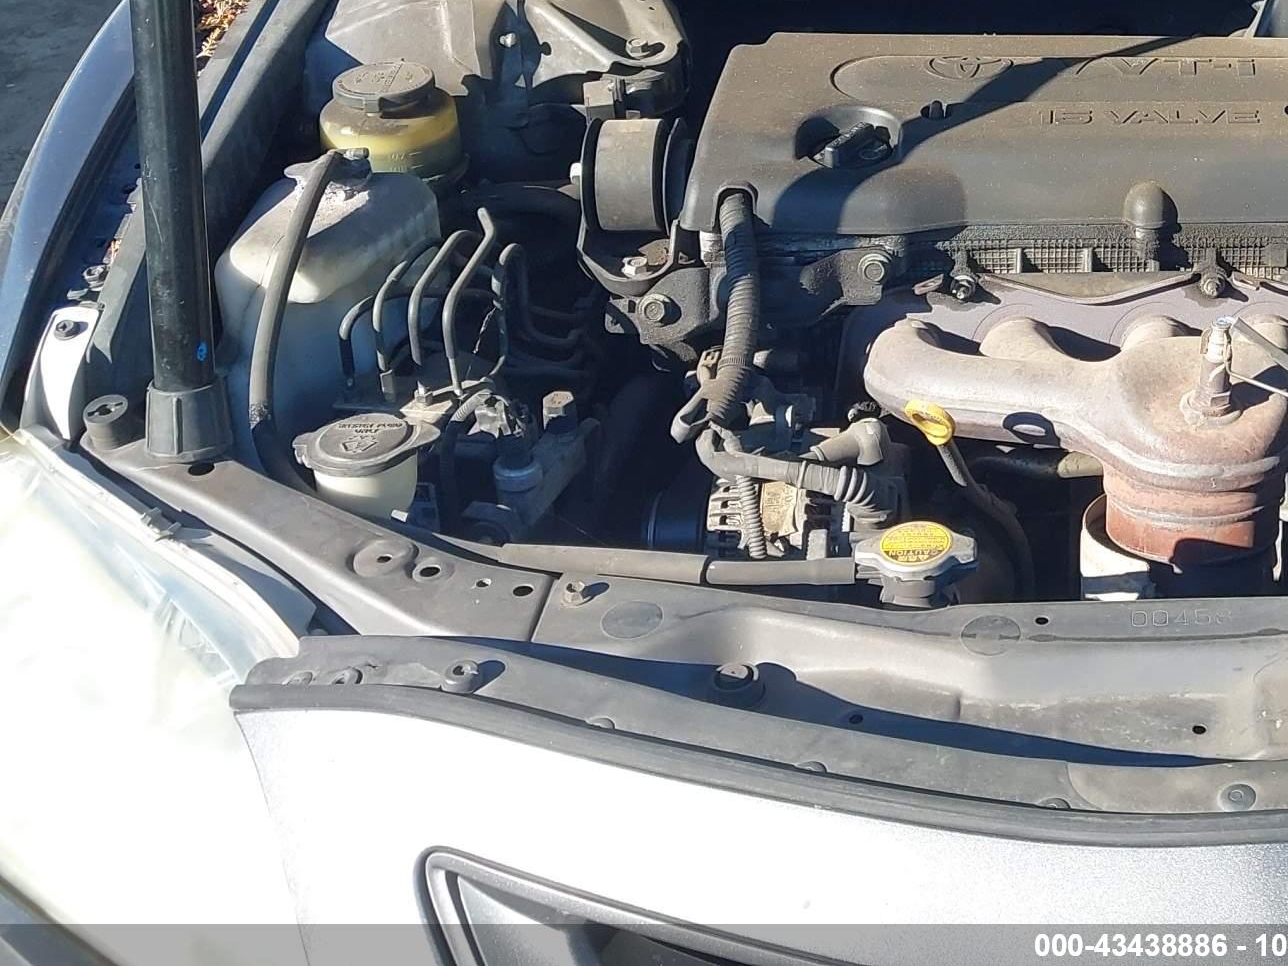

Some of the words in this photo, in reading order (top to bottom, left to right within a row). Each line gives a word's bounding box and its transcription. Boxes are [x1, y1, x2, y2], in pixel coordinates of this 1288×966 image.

[1038, 110, 1093, 126] 16
[1109, 110, 1262, 125] VALVE
[888, 549, 938, 557] CAUTION
